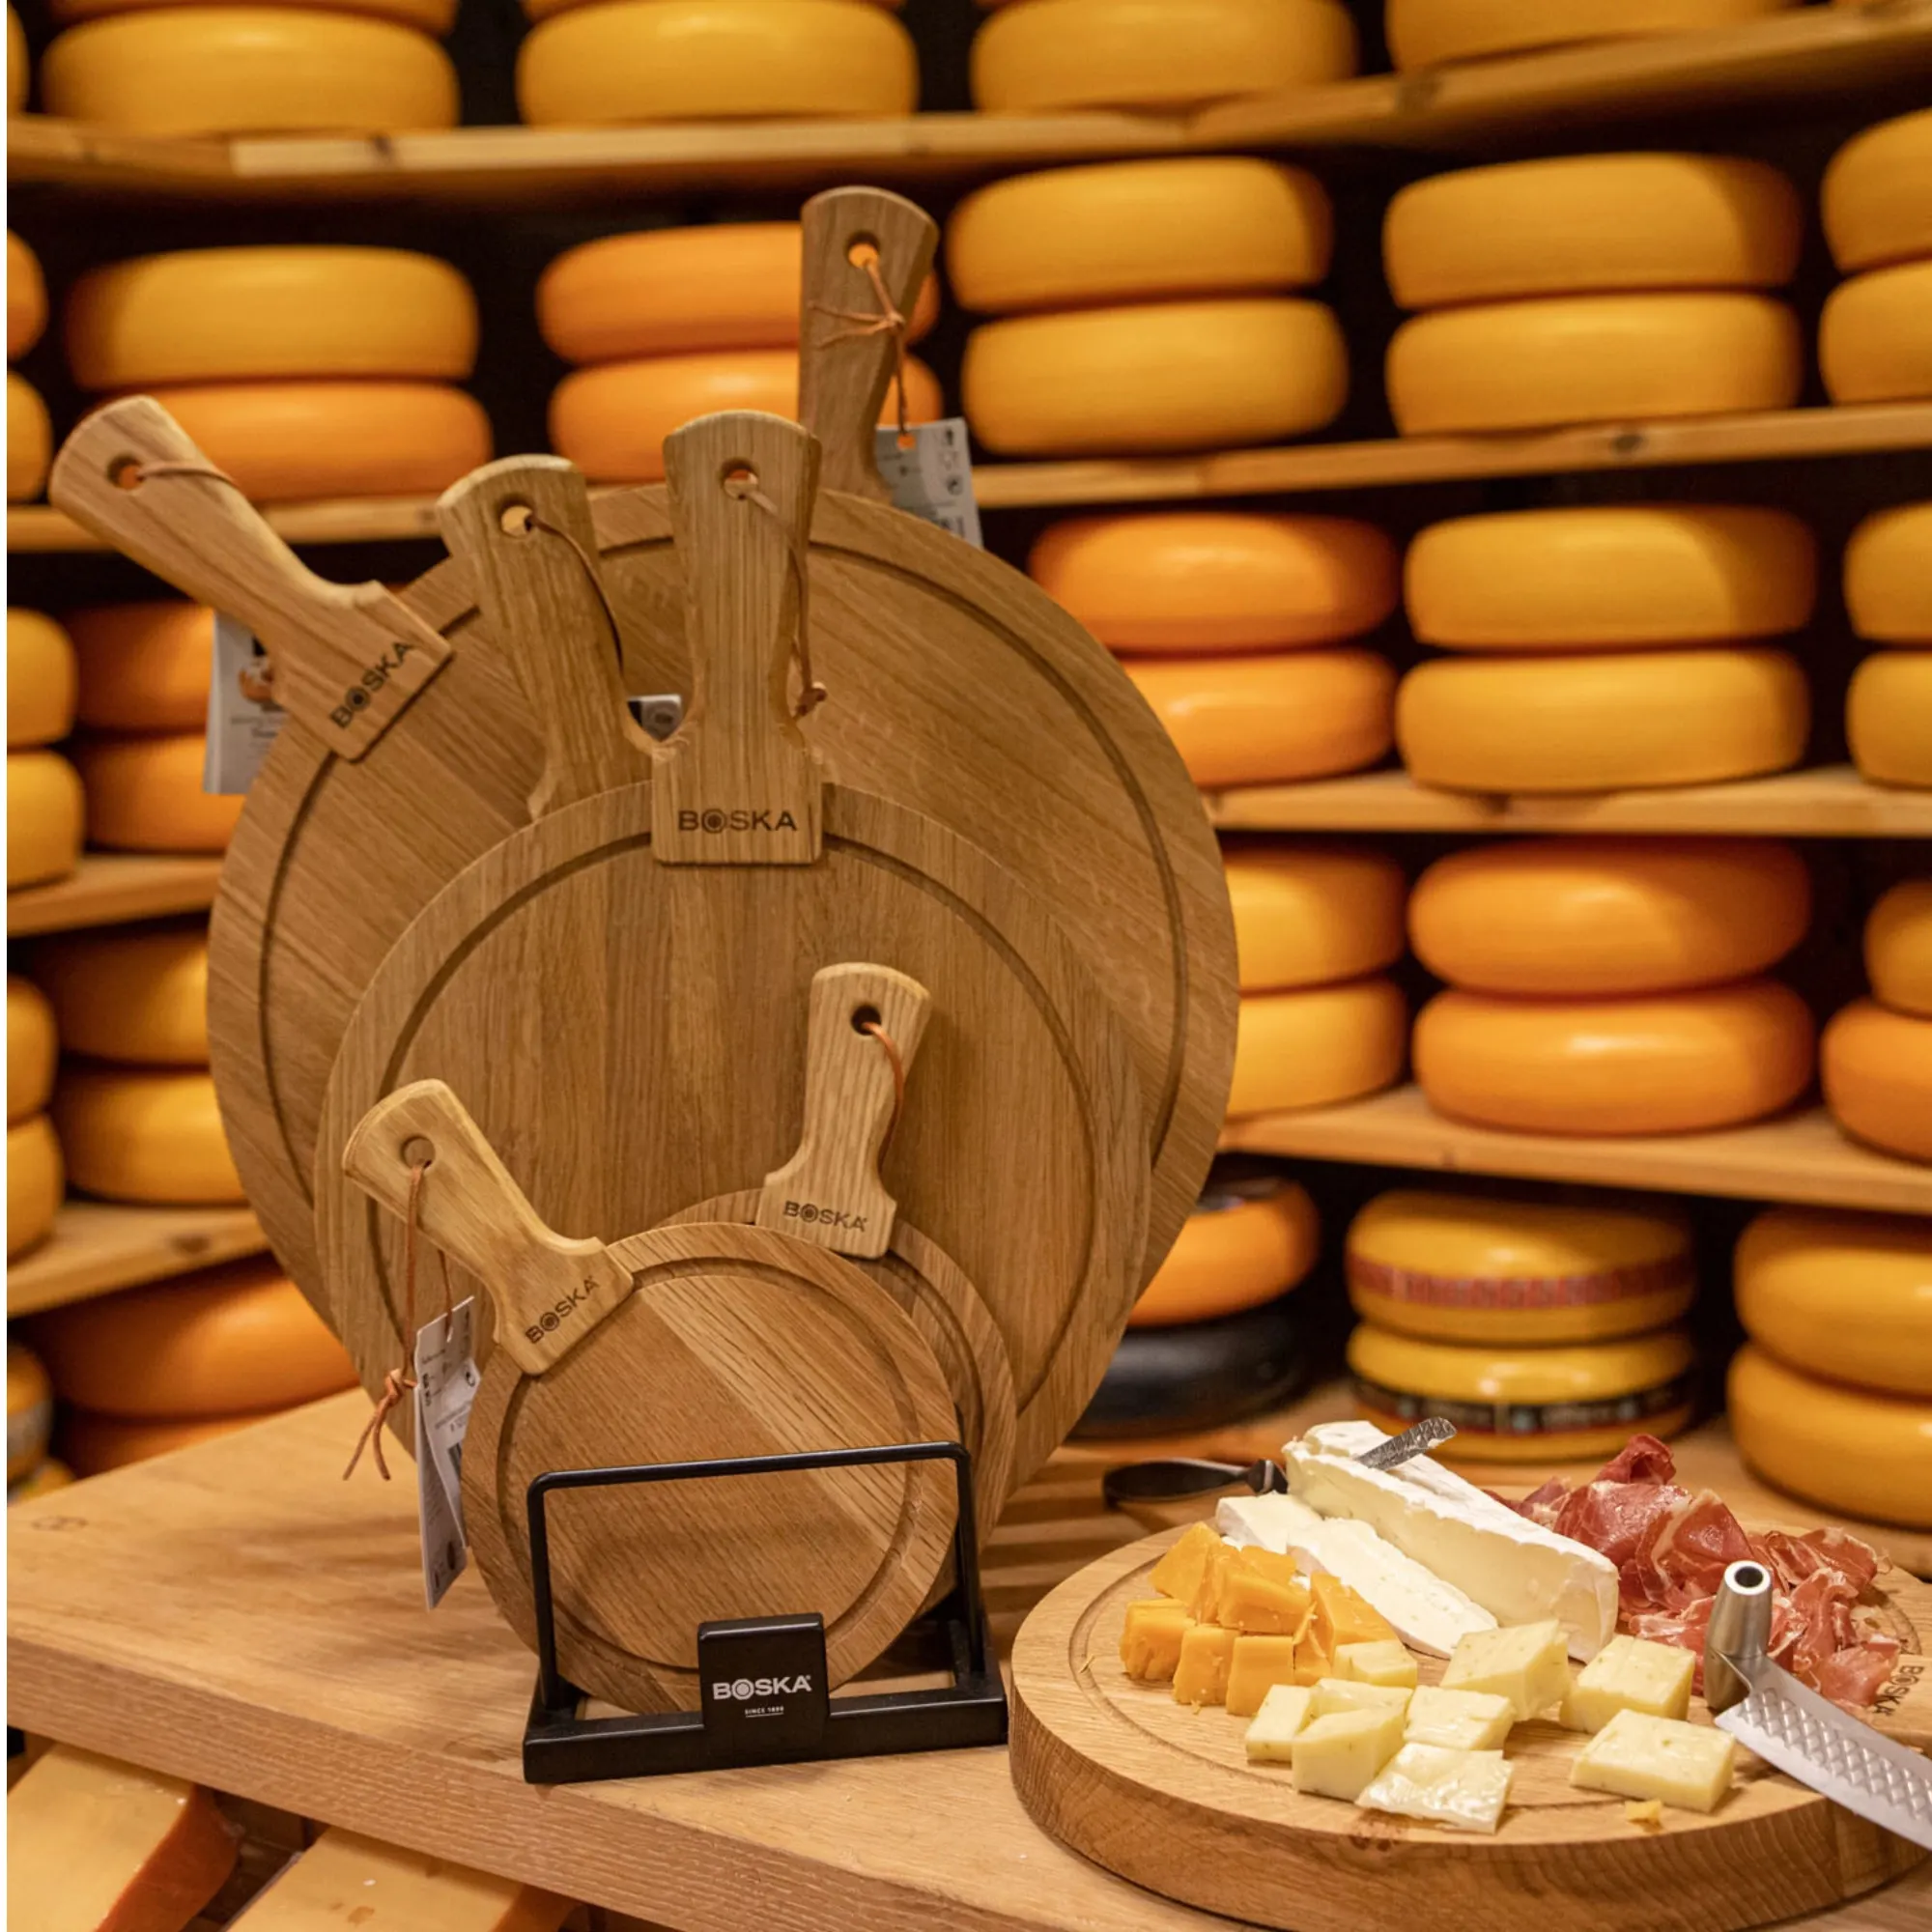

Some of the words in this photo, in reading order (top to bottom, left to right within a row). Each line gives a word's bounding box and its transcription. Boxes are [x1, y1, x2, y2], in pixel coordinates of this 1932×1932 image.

[329, 641, 414, 729] BOSKA
[678, 809, 798, 834] BOSKA
[782, 1201, 867, 1233] BOSKA
[525, 1276, 600, 1344] BOSKA
[712, 1675, 812, 1700] BOSKA
[1872, 1664, 1925, 1717] BOSKA
